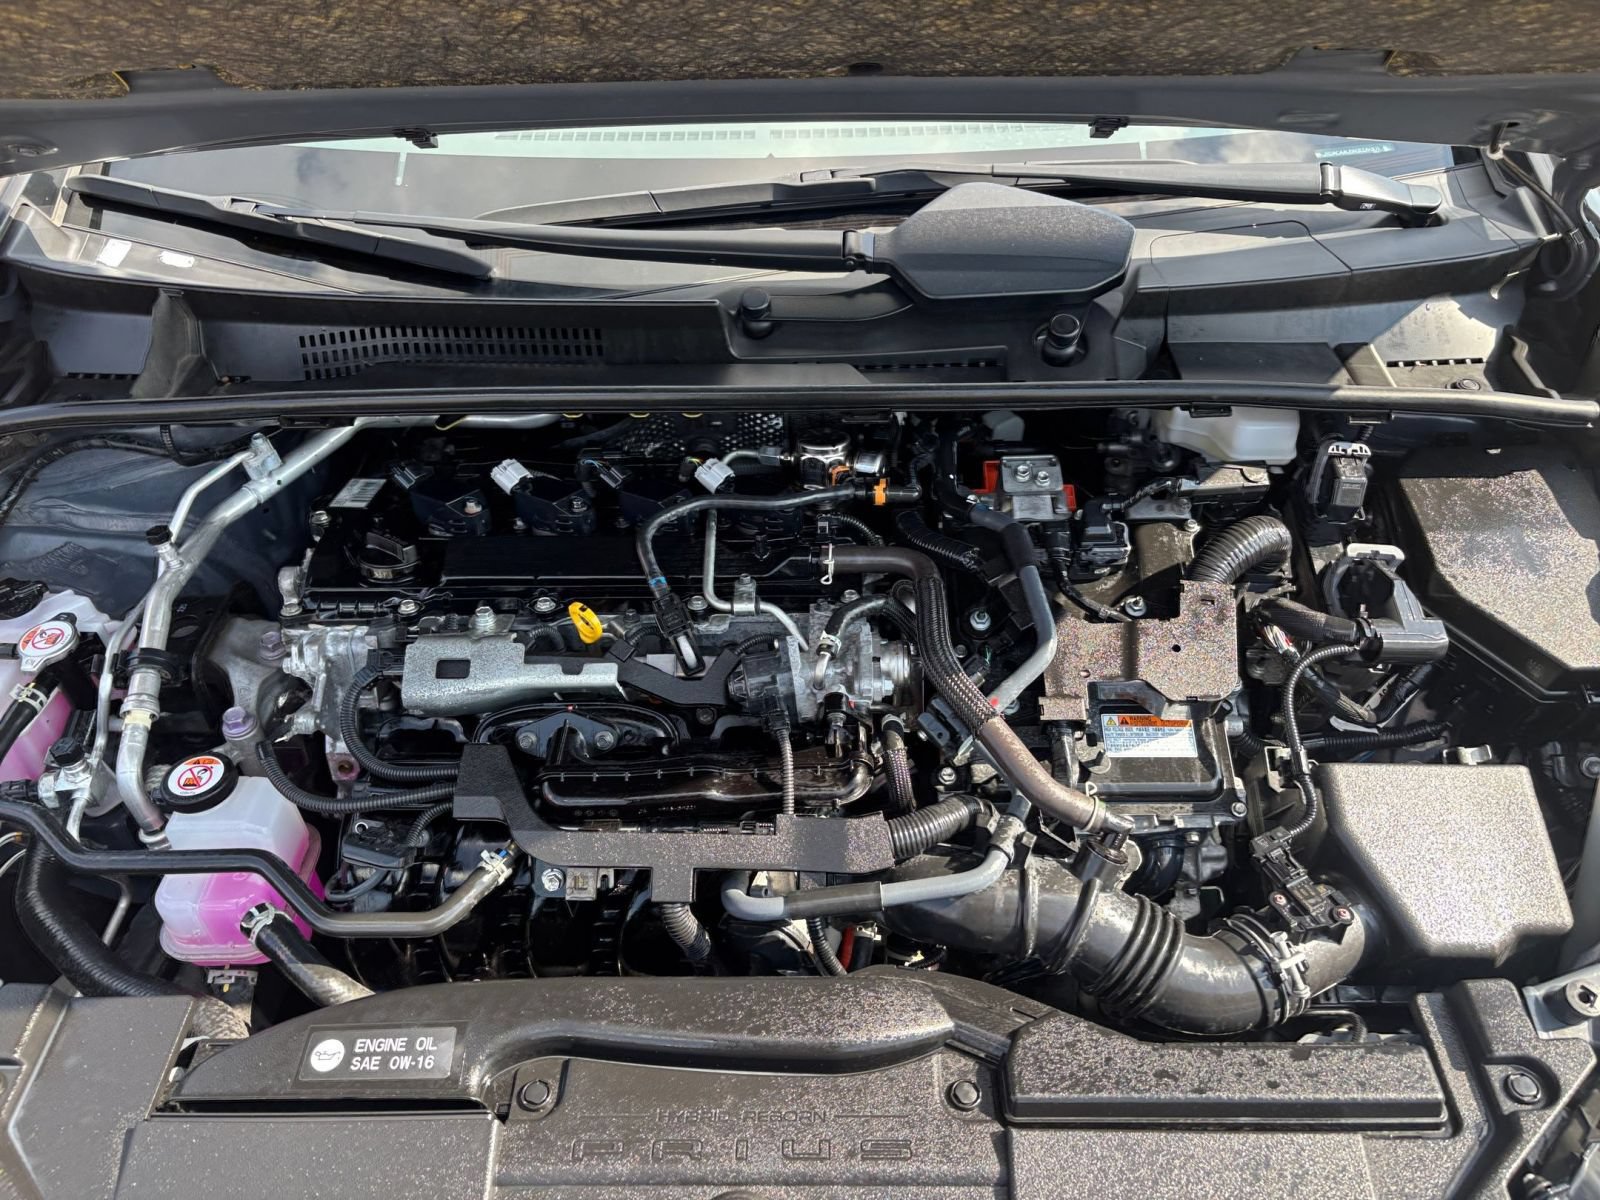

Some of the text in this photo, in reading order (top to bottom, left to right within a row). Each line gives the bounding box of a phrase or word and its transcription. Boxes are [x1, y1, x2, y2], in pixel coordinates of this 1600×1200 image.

[354, 1036, 438, 1053] ENGINE OIL
[350, 1055, 435, 1071] SAE 0W-16
[655, 1108, 827, 1123] HYBRID REBORN
[571, 1138, 913, 1161] PRIUS
